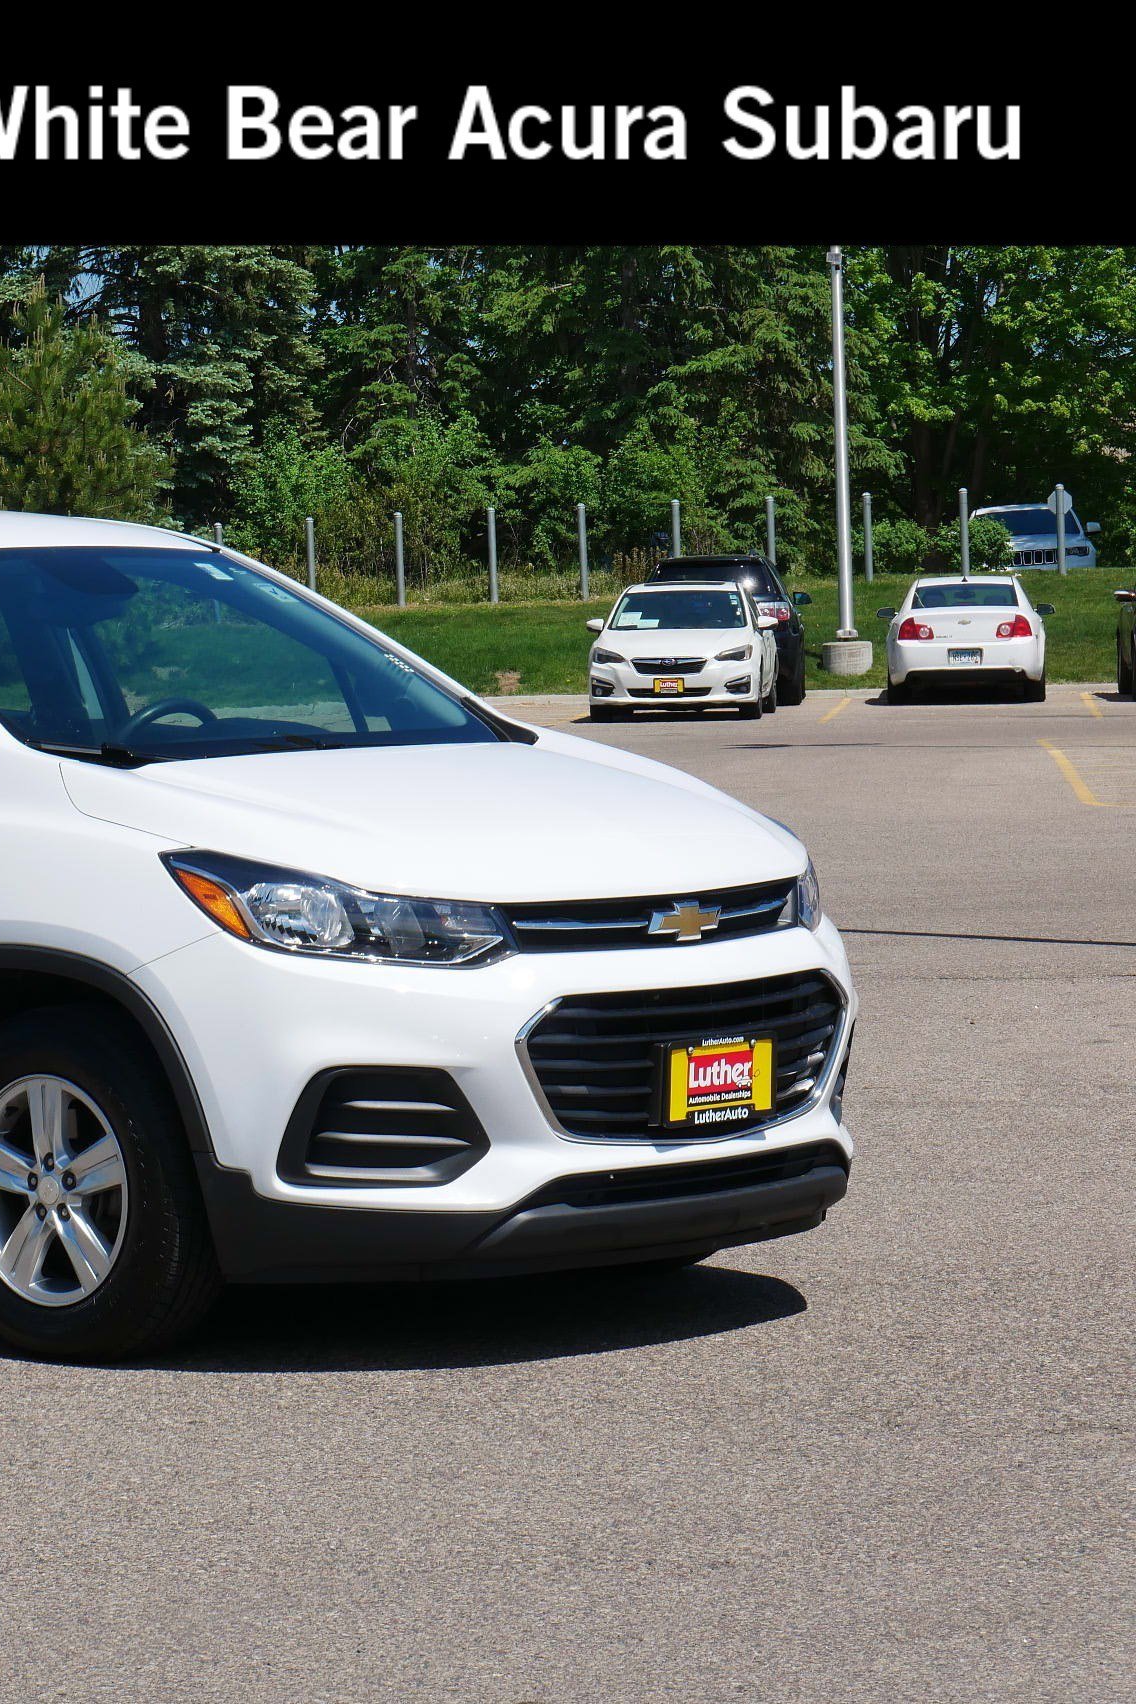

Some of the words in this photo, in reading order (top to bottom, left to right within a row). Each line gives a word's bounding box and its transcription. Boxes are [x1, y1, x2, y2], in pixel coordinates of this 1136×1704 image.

[701, 1036, 744, 1047] LutherAuto.com
[688, 1058, 753, 1088] Luther
[688, 1093, 721, 1105] Automobile
[721, 1090, 751, 1101] Dealerships
[694, 1106, 749, 1124] LutherAuto
